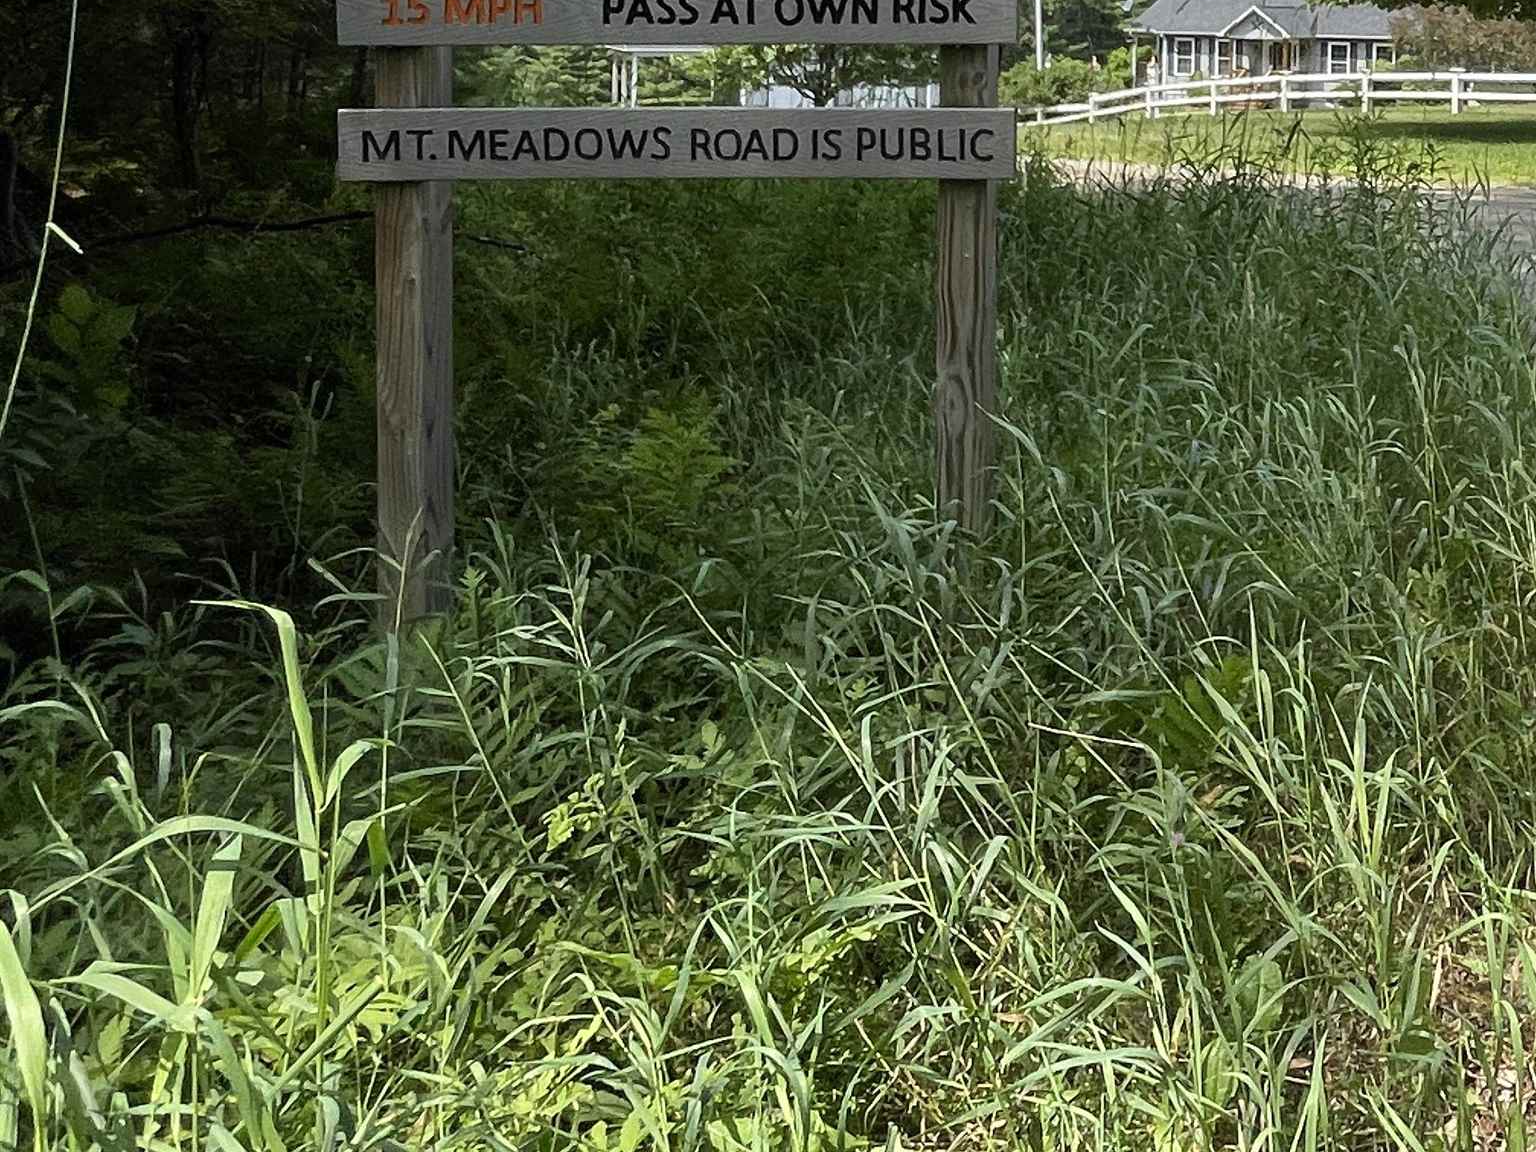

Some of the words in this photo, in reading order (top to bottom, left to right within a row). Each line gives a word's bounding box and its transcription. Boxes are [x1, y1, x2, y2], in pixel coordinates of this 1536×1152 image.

[361, 129, 438, 163] MT.
[447, 126, 672, 162] MEADOWS
[690, 128, 799, 162] ROAD
[811, 129, 843, 161] IS
[856, 127, 995, 162] PUBLIC
